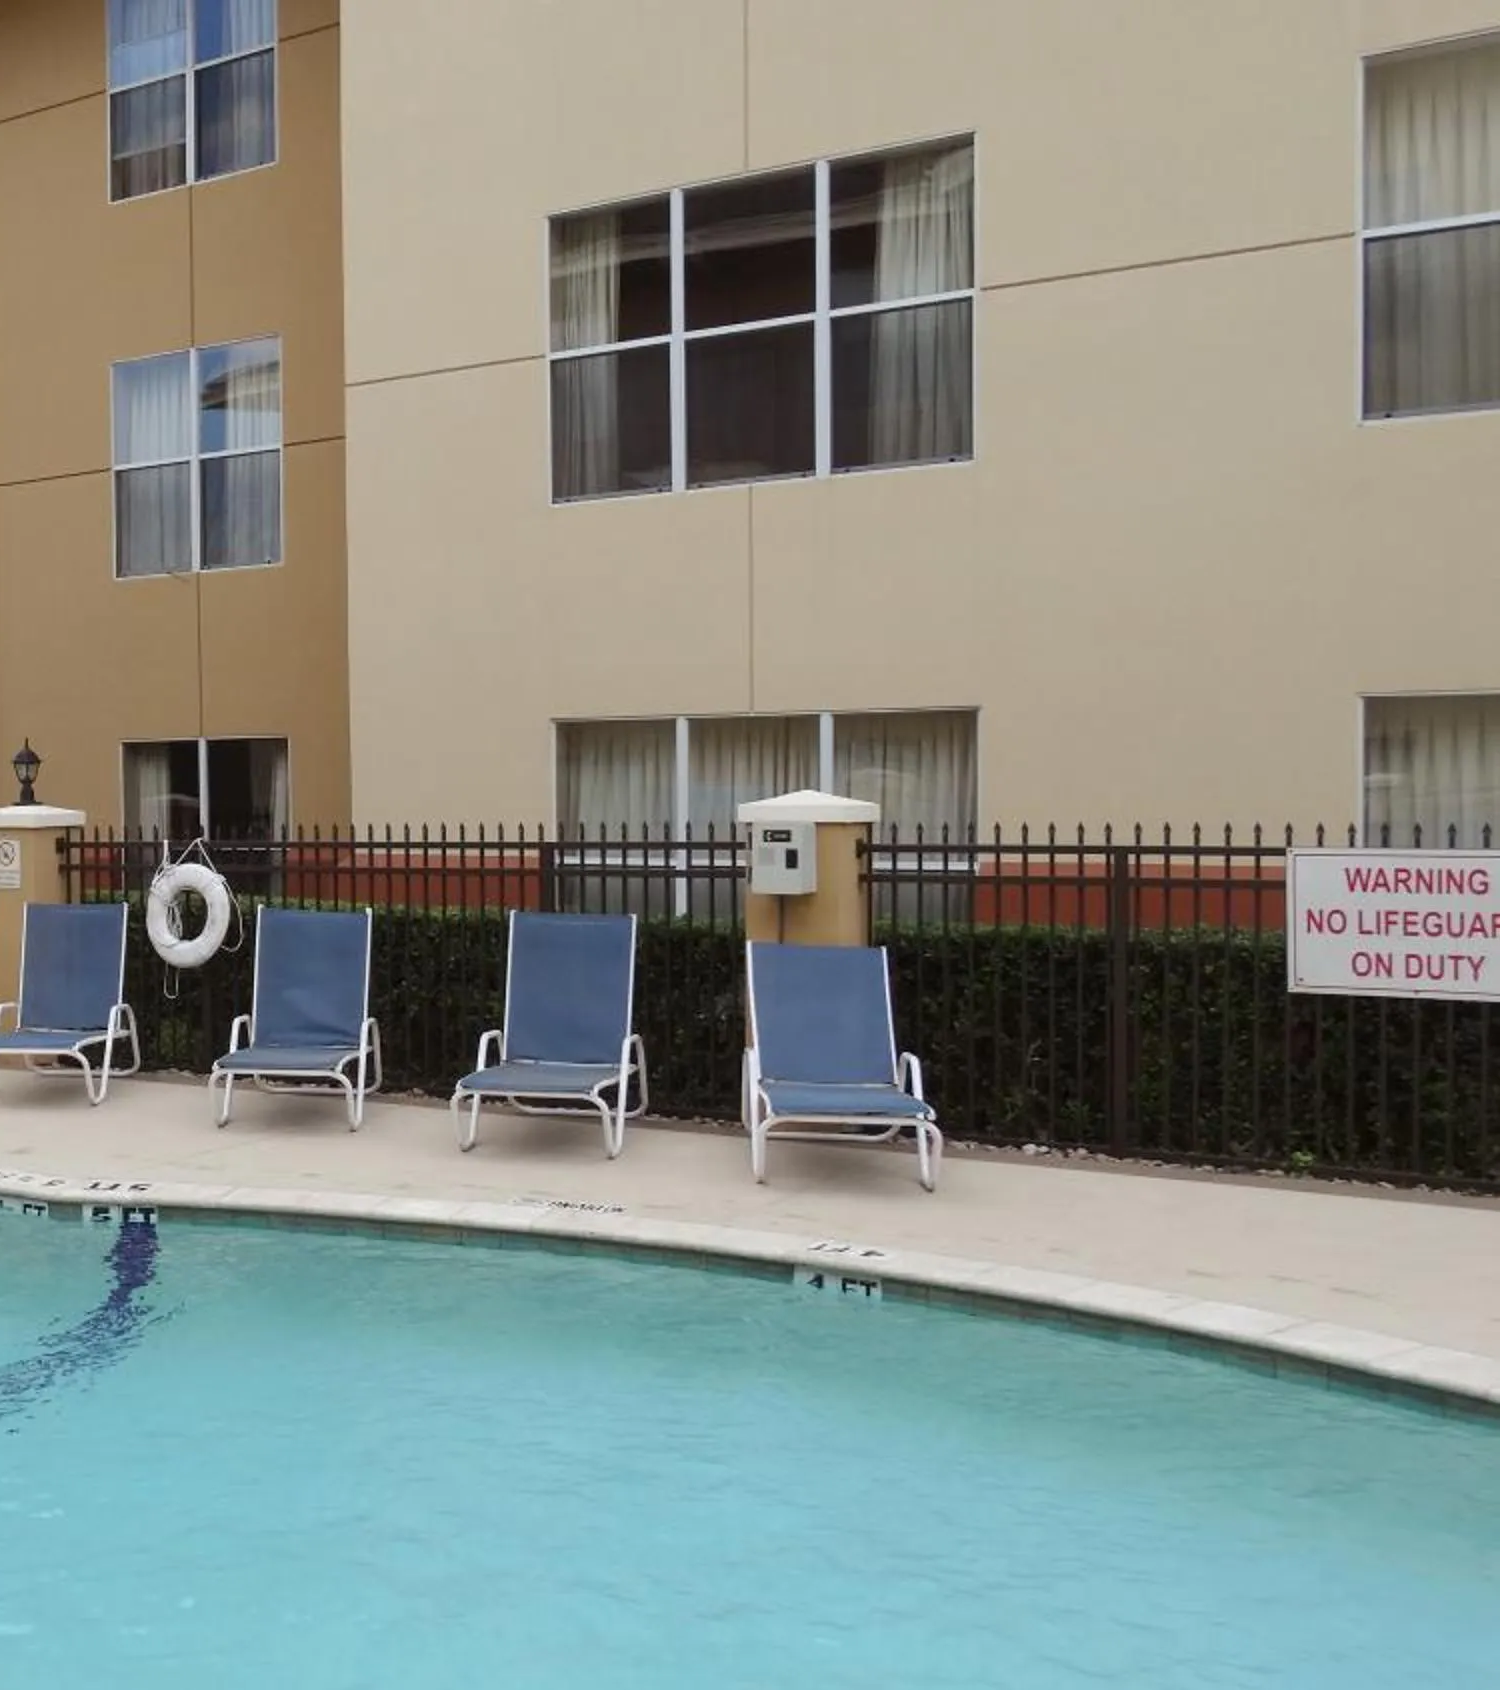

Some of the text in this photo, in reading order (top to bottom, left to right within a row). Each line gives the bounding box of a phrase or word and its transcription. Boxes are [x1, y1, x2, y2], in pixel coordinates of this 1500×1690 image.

[1344, 867, 1489, 895] WARNING
[1306, 909, 1347, 934] NO
[1351, 952, 1485, 981] ON DUTY
[841, 1277, 878, 1297] FT
